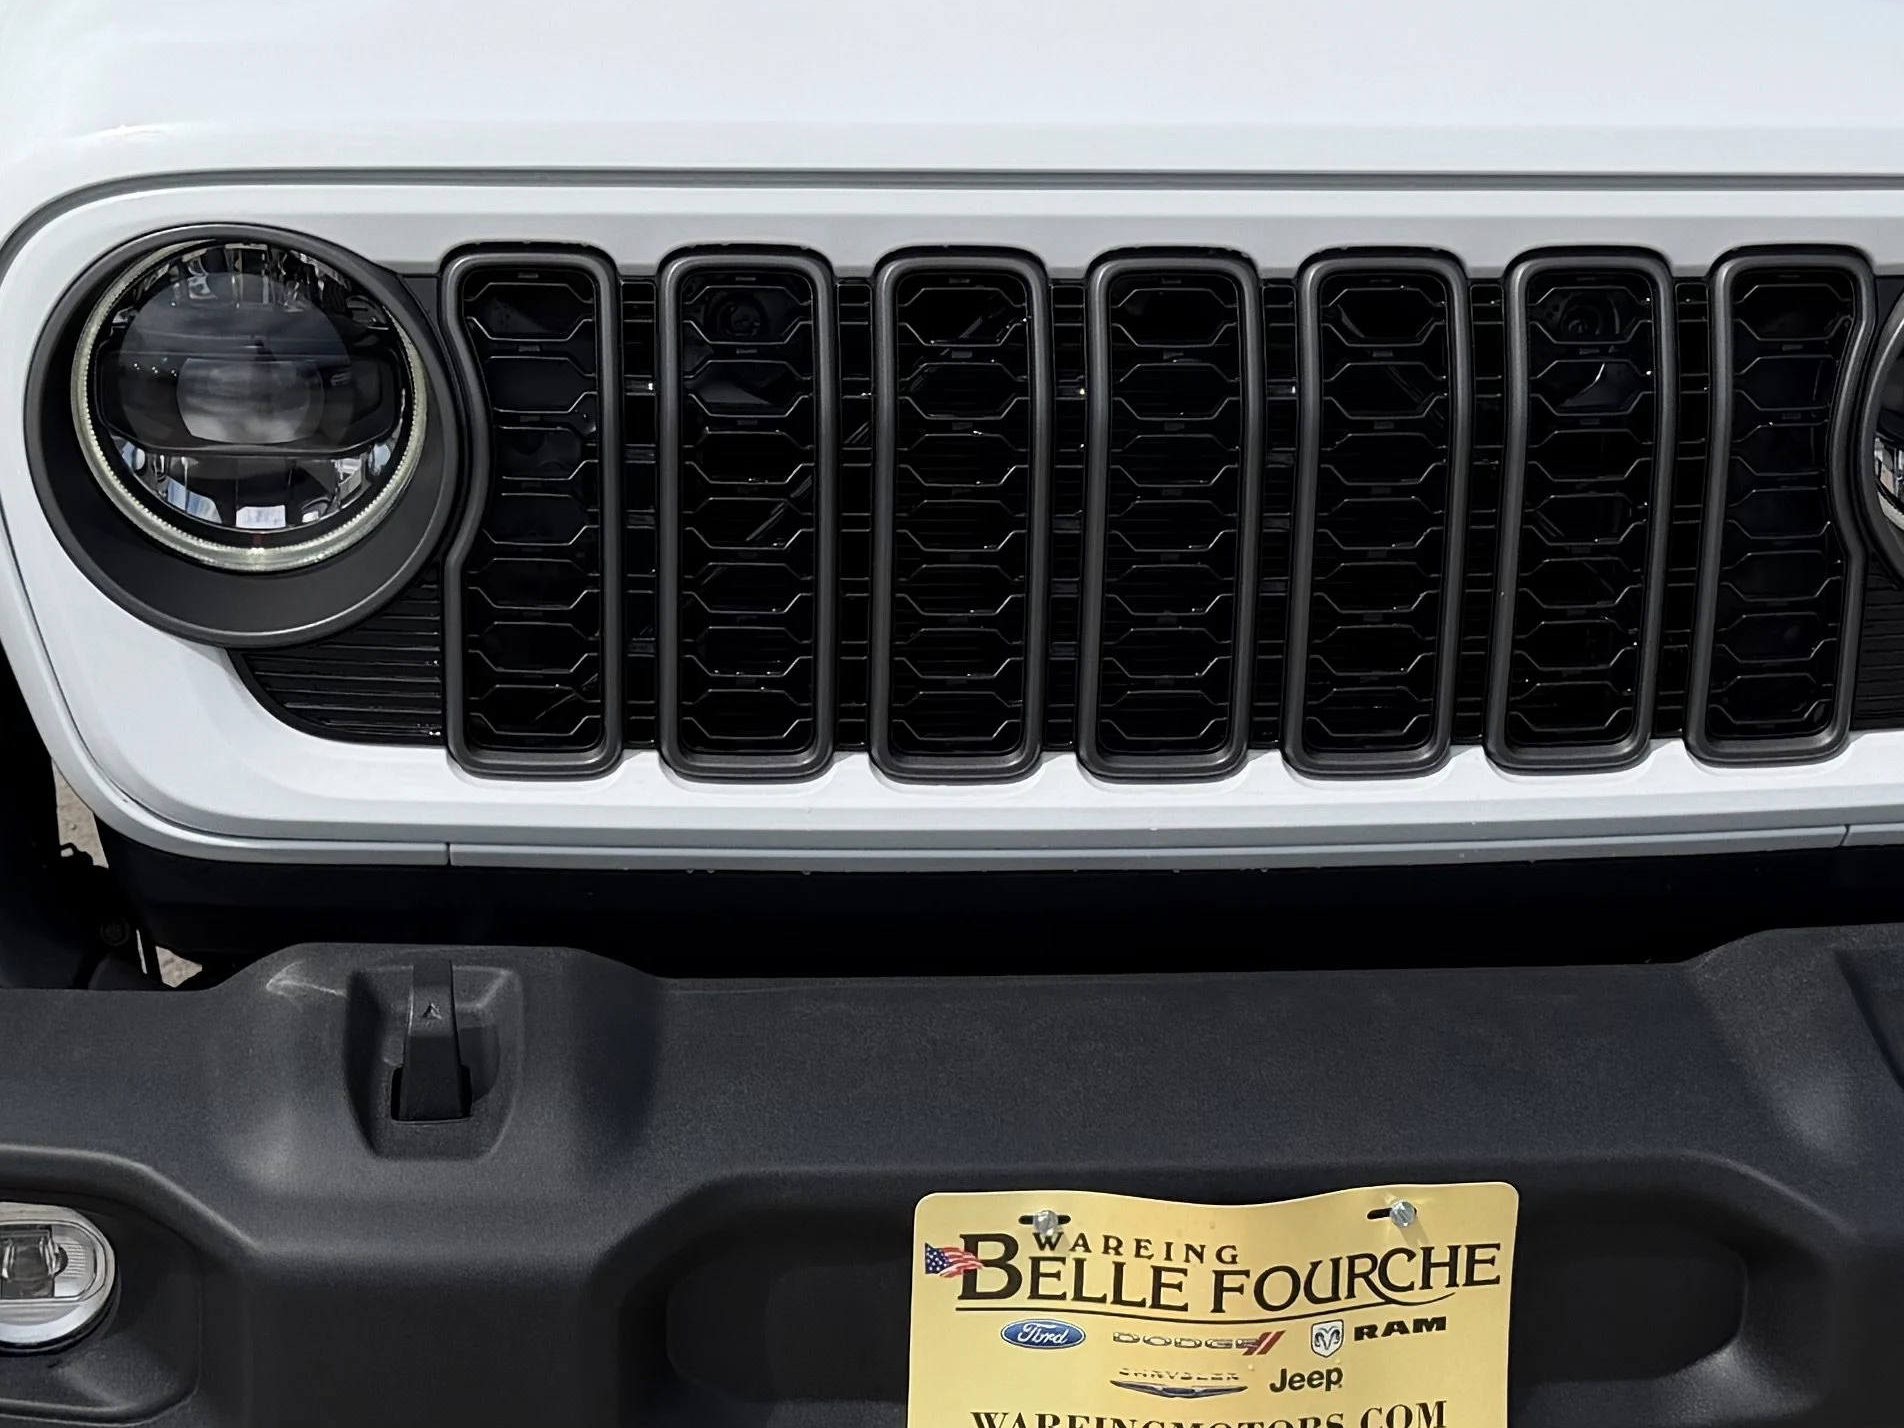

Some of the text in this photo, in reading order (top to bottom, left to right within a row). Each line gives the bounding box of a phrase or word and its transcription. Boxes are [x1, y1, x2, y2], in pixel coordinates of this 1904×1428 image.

[1032, 1232, 1239, 1264] WAREING
[957, 1233, 1501, 1314] BELLE FOURCHE
[1112, 1332, 1261, 1349] DODGE
[1353, 1316, 1447, 1341] RAM
[1269, 1367, 1344, 1392] Jeep
